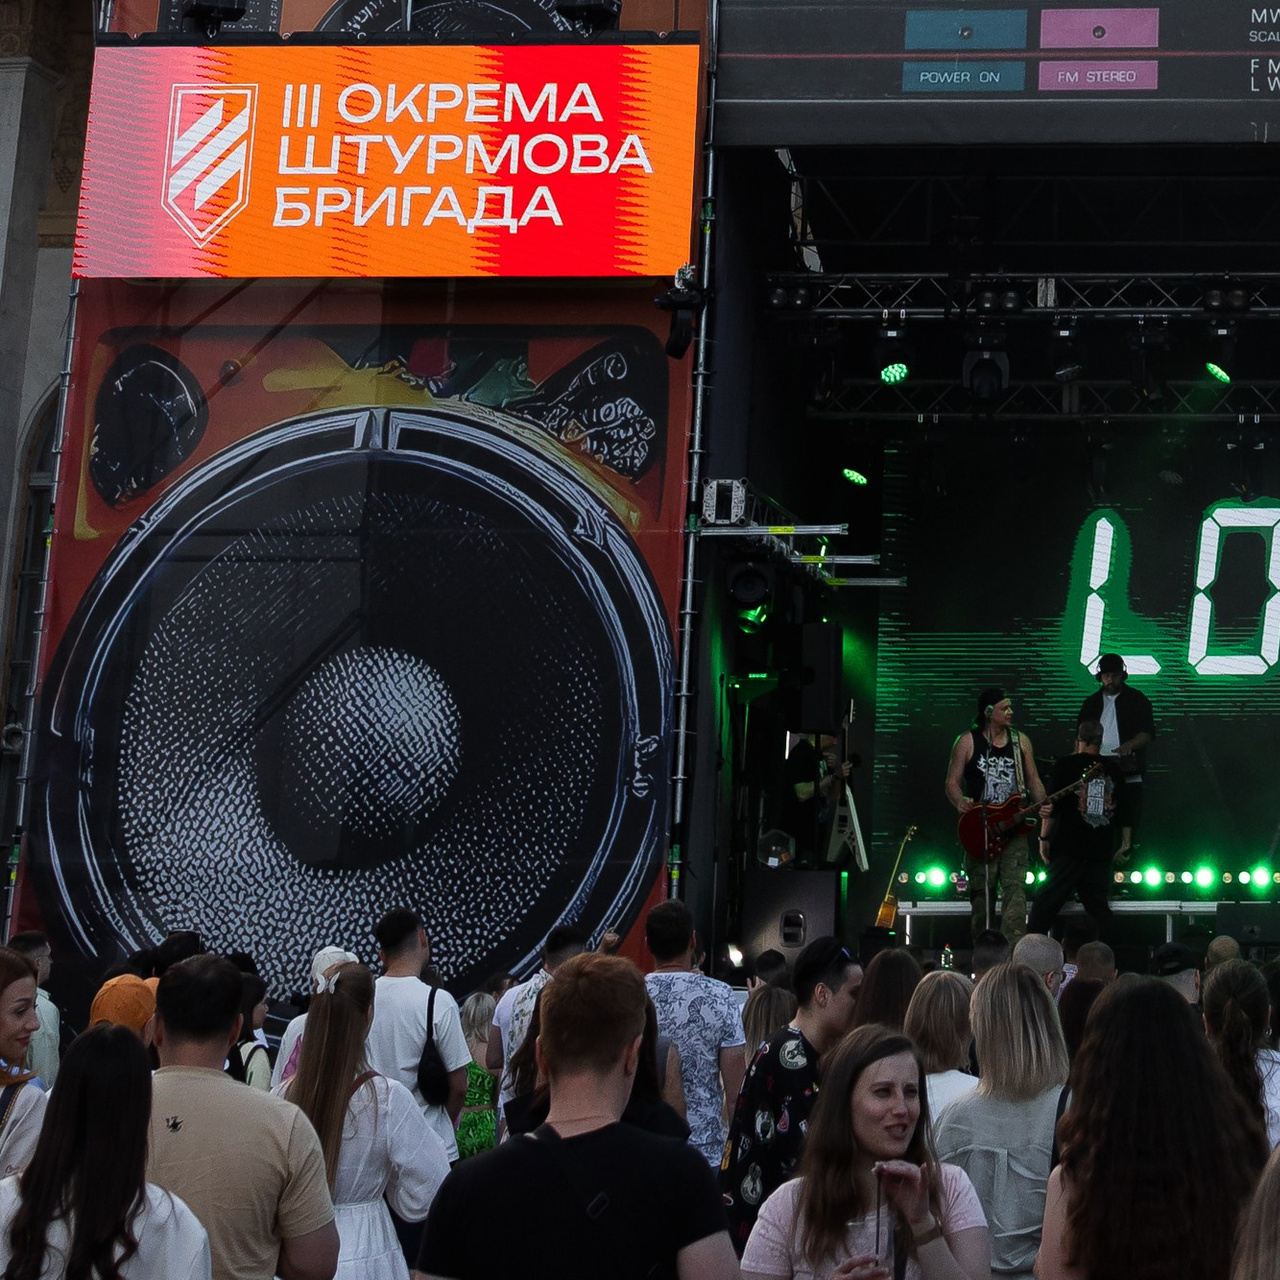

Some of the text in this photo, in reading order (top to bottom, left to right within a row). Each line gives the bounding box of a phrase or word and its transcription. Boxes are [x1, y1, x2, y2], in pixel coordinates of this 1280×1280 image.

[919, 71, 1000, 83] POWER ON
[1057, 70, 1137, 83] FM STEREO
[337, 82, 604, 123] ОКРЕМА
[277, 133, 654, 176] ШТУРМОВА
[272, 185, 564, 234] БРИГАДА
